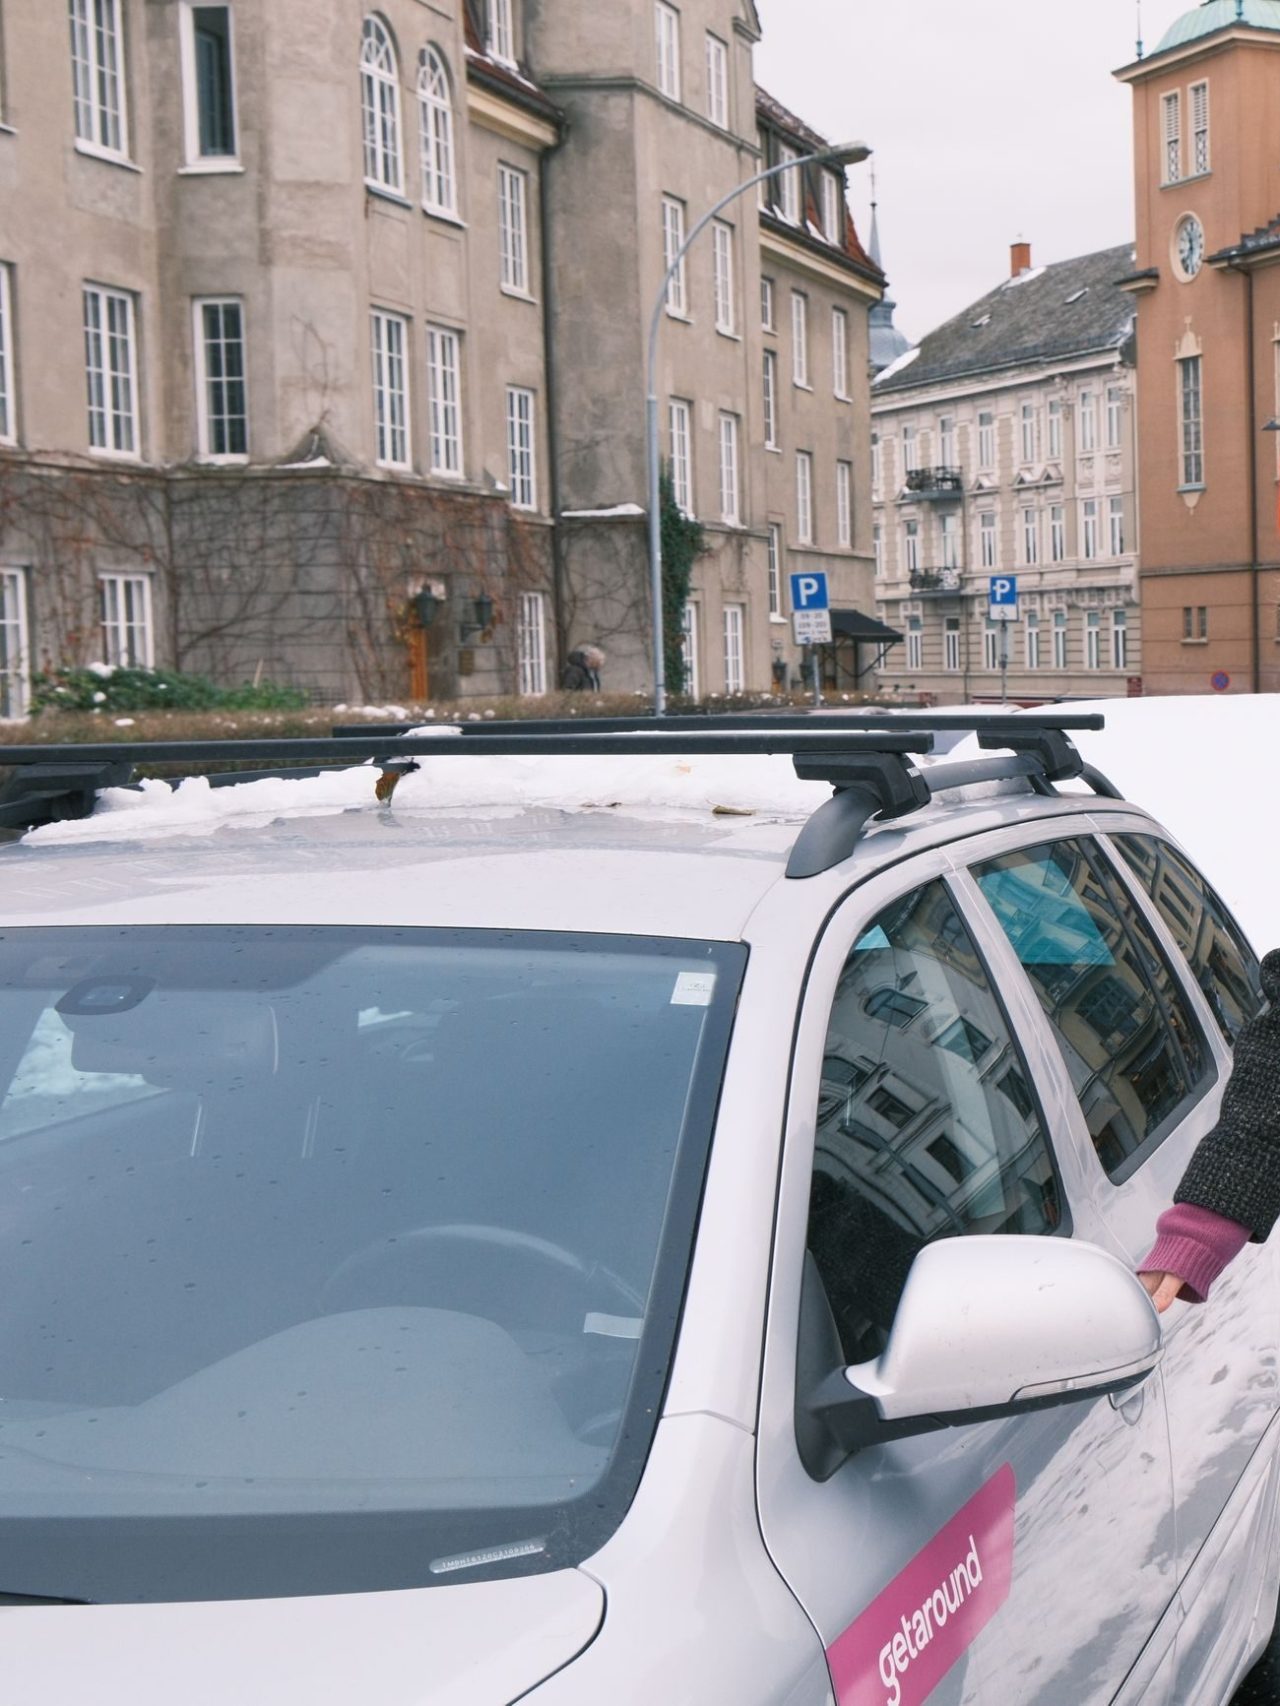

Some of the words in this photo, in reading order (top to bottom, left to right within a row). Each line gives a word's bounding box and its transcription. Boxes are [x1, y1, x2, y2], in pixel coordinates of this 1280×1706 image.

[799, 577, 819, 606] P
[996, 579, 1010, 601] P
[878, 1534, 983, 1706] getaround
